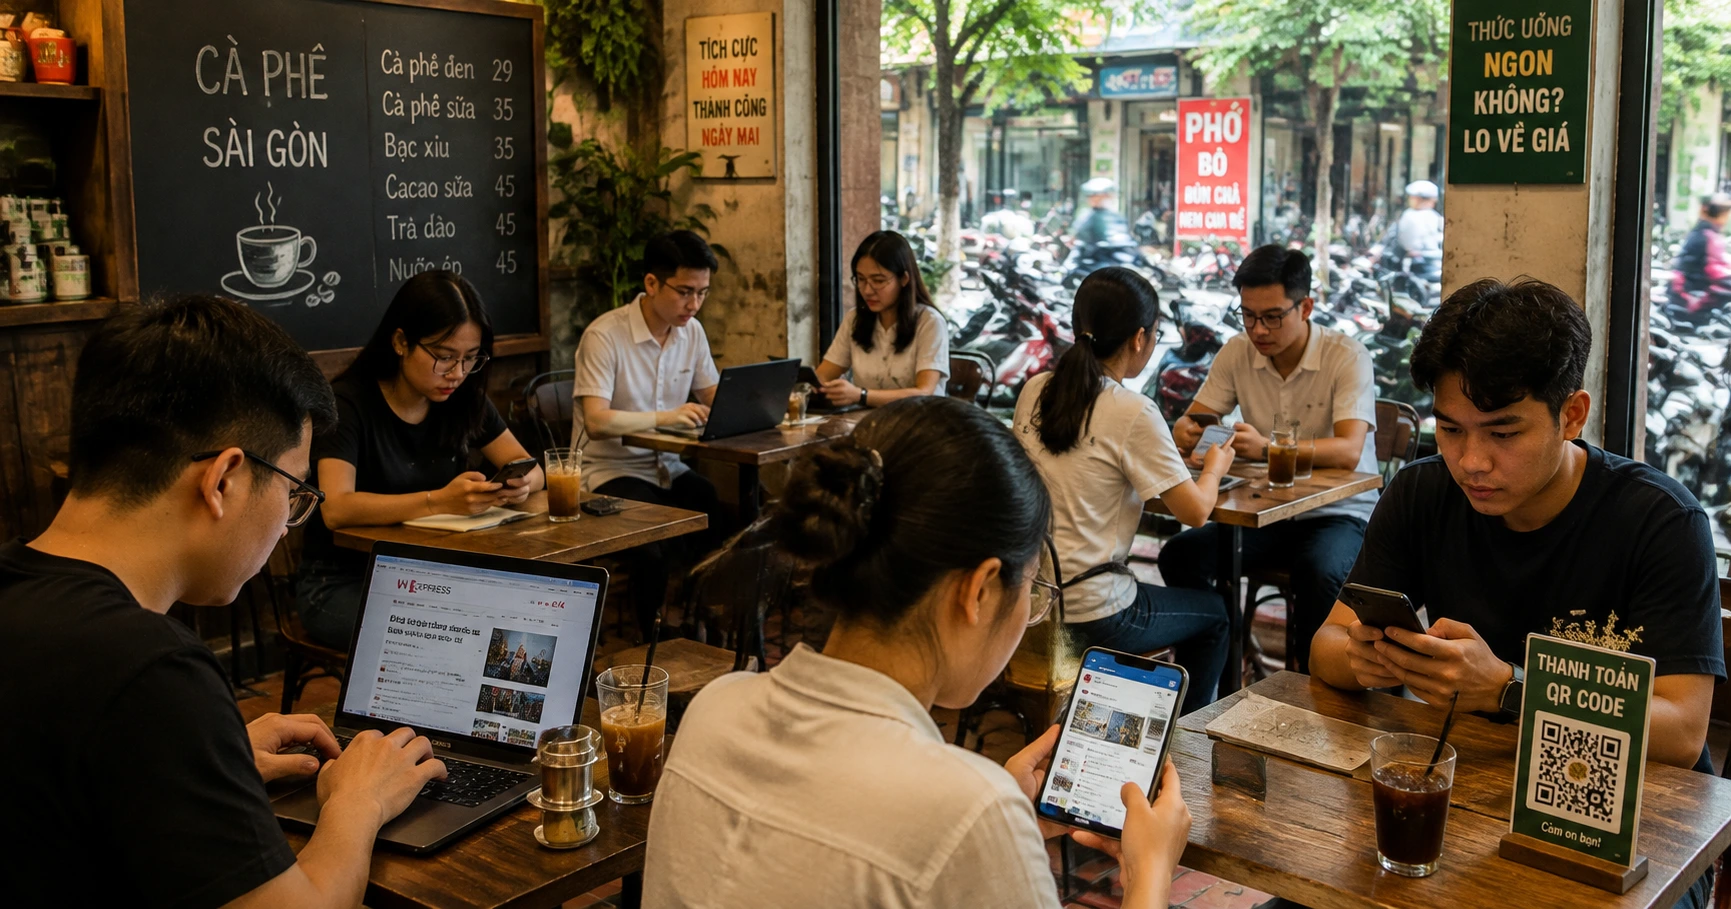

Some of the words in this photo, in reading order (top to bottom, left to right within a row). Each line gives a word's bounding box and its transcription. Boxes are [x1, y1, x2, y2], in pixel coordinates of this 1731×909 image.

[1468, 14, 1515, 42] THỨC
[699, 37, 728, 60] TÍCH
[195, 34, 248, 96] CÀ
[262, 43, 328, 100] PHÊ
[381, 49, 403, 75] Cà
[492, 59, 513, 82] 29
[733, 67, 757, 87] NAY
[1484, 49, 1553, 78] NGON
[382, 90, 405, 116] Cà
[411, 92, 440, 124] phê
[493, 97, 513, 121] 35
[1474, 82, 1565, 115] KHÔNG?
[202, 117, 254, 168] SÀI
[266, 120, 328, 168] GÒN
[384, 132, 418, 162] Bạc
[424, 135, 449, 158] xiu
[494, 136, 514, 159] 35
[737, 127, 760, 146] MAI
[1463, 128, 1491, 153] LO
[1532, 121, 1570, 153] GIÁ
[385, 173, 439, 199] Cacao
[495, 174, 515, 198] 45
[387, 215, 418, 240] Trà
[495, 212, 516, 236] 45
[495, 250, 517, 275] 45
[1537, 653, 1590, 681] THANH
[1546, 682, 1572, 706] QR
[1577, 689, 1625, 718] CODE
